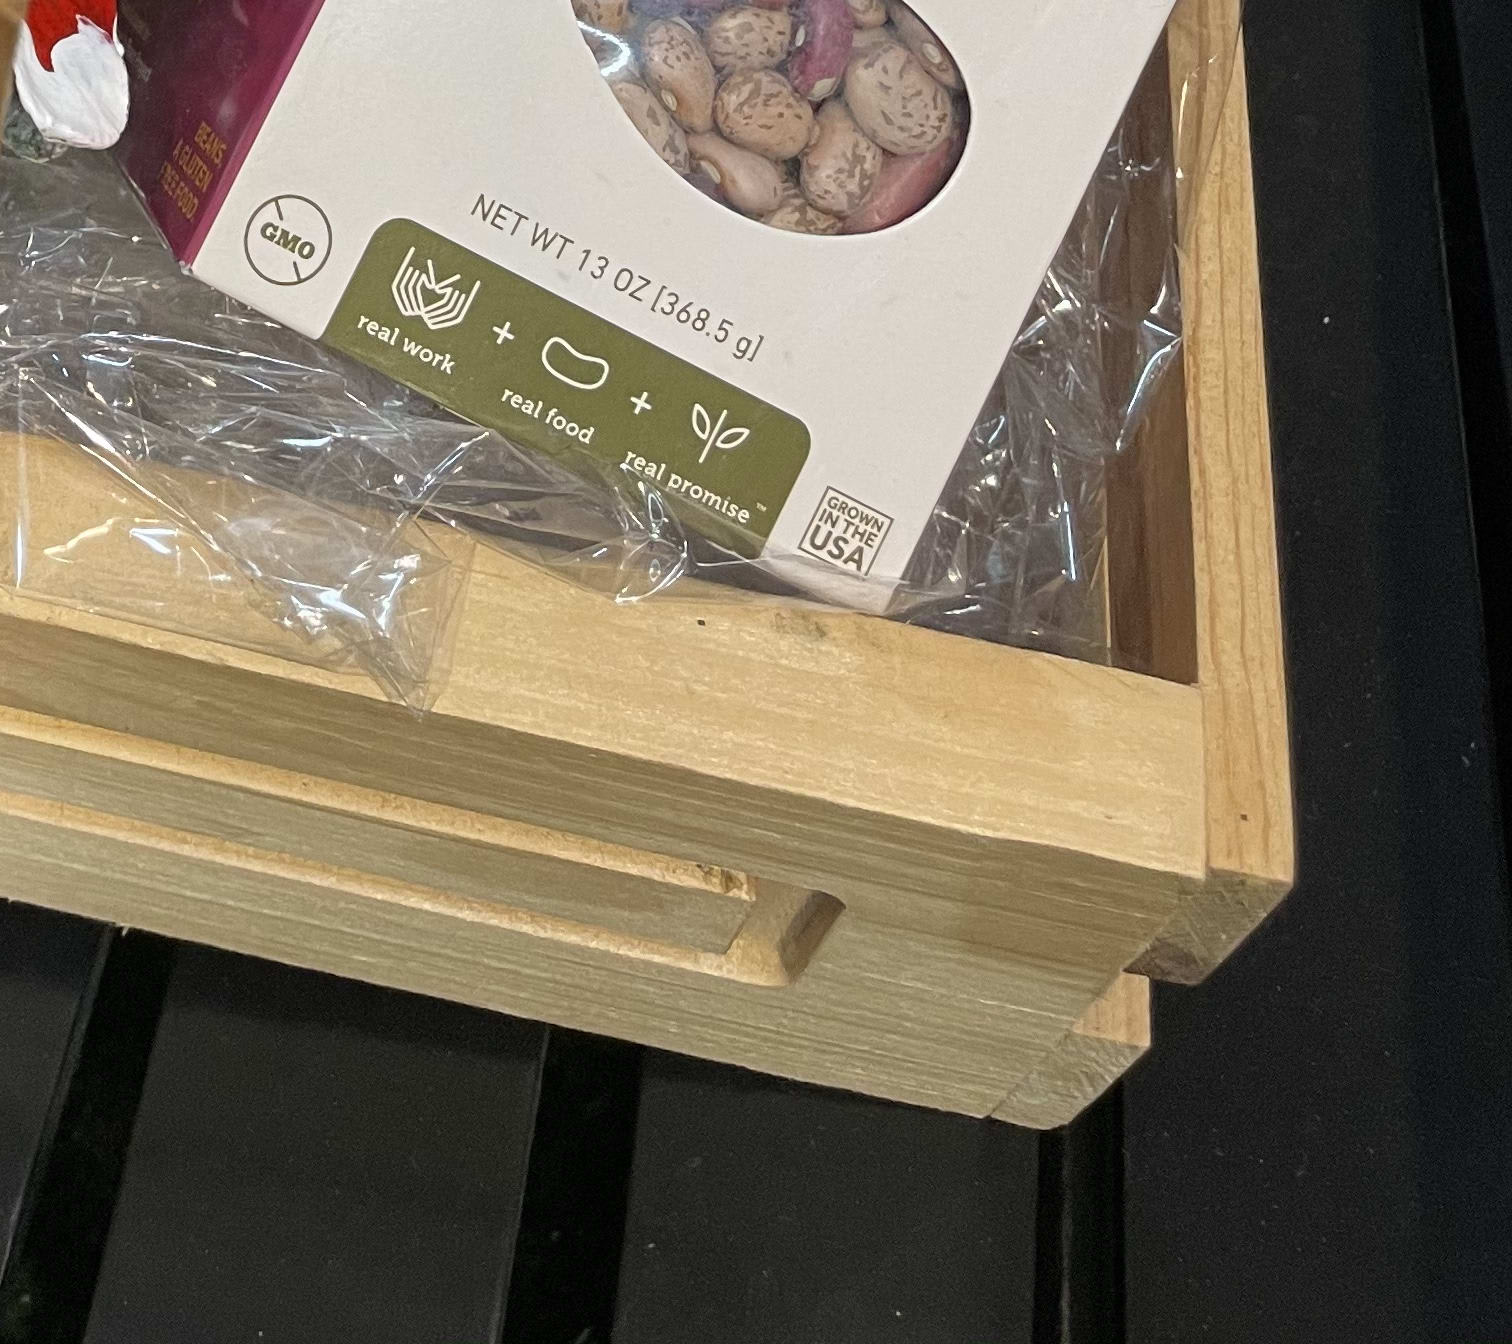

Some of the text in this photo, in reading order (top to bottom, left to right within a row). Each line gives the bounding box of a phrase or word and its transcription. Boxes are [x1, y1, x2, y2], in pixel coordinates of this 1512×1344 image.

[259, 220, 316, 262] GMO
[470, 193, 531, 237] NET
[530, 221, 575, 261] WT
[580, 248, 606, 280] 13
[614, 267, 651, 302] OZ
[356, 312, 457, 375] real work
[500, 387, 596, 445] real food
[622, 448, 668, 485] real
[665, 471, 752, 525] promise
[818, 507, 879, 549] IN THE
[827, 496, 885, 533] GROWN
[809, 524, 865, 572] USA
